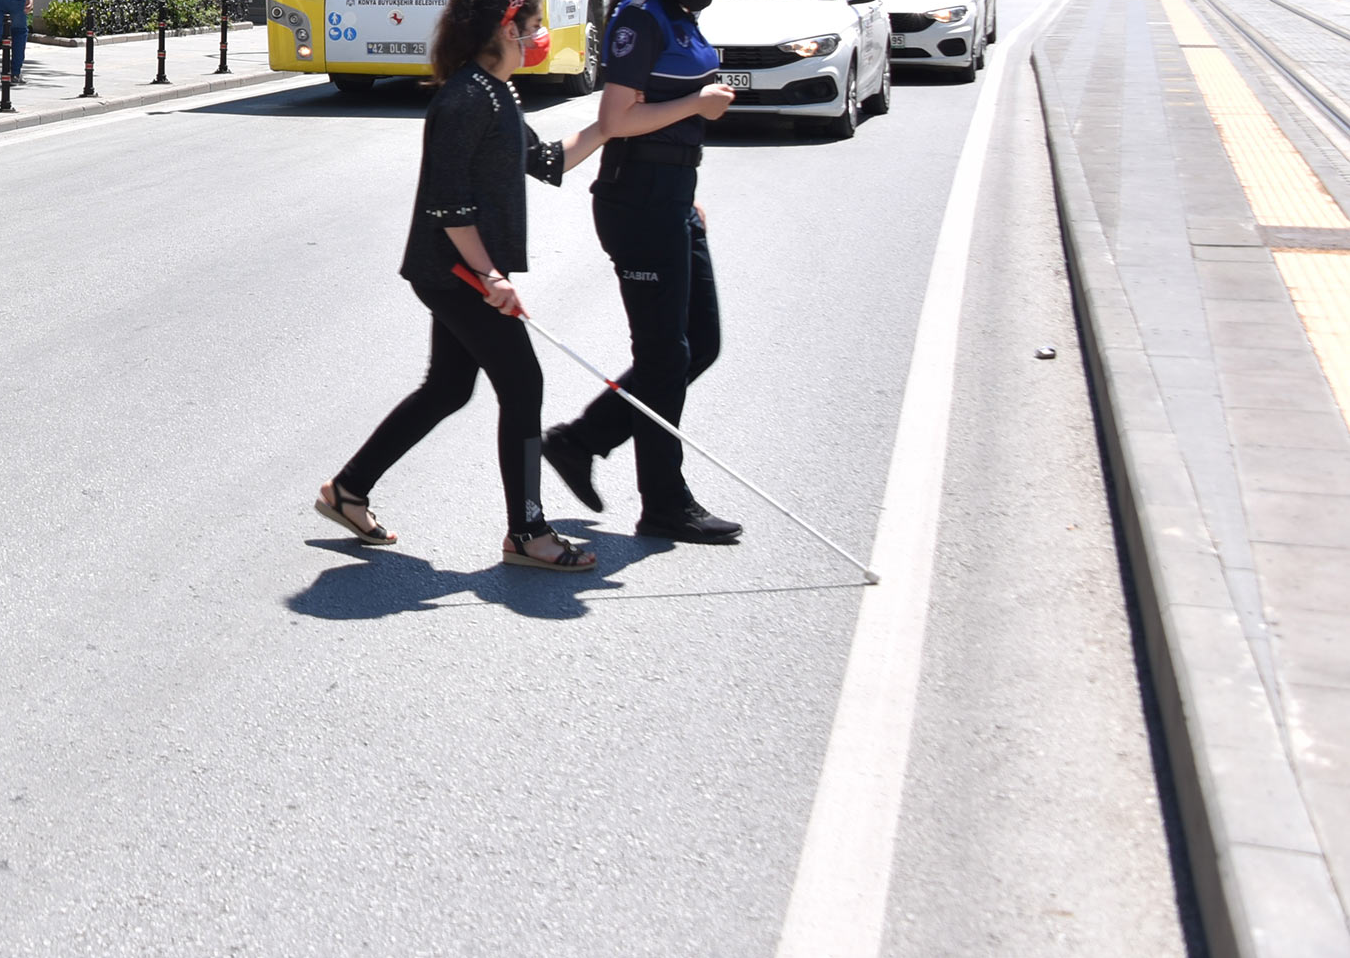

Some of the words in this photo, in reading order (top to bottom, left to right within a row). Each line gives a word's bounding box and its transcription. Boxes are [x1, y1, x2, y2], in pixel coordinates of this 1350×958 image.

[372, 44, 383, 54] 42
[413, 44, 424, 54] 25
[726, 74, 748, 86] 350
[622, 269, 659, 281] ZABITA
